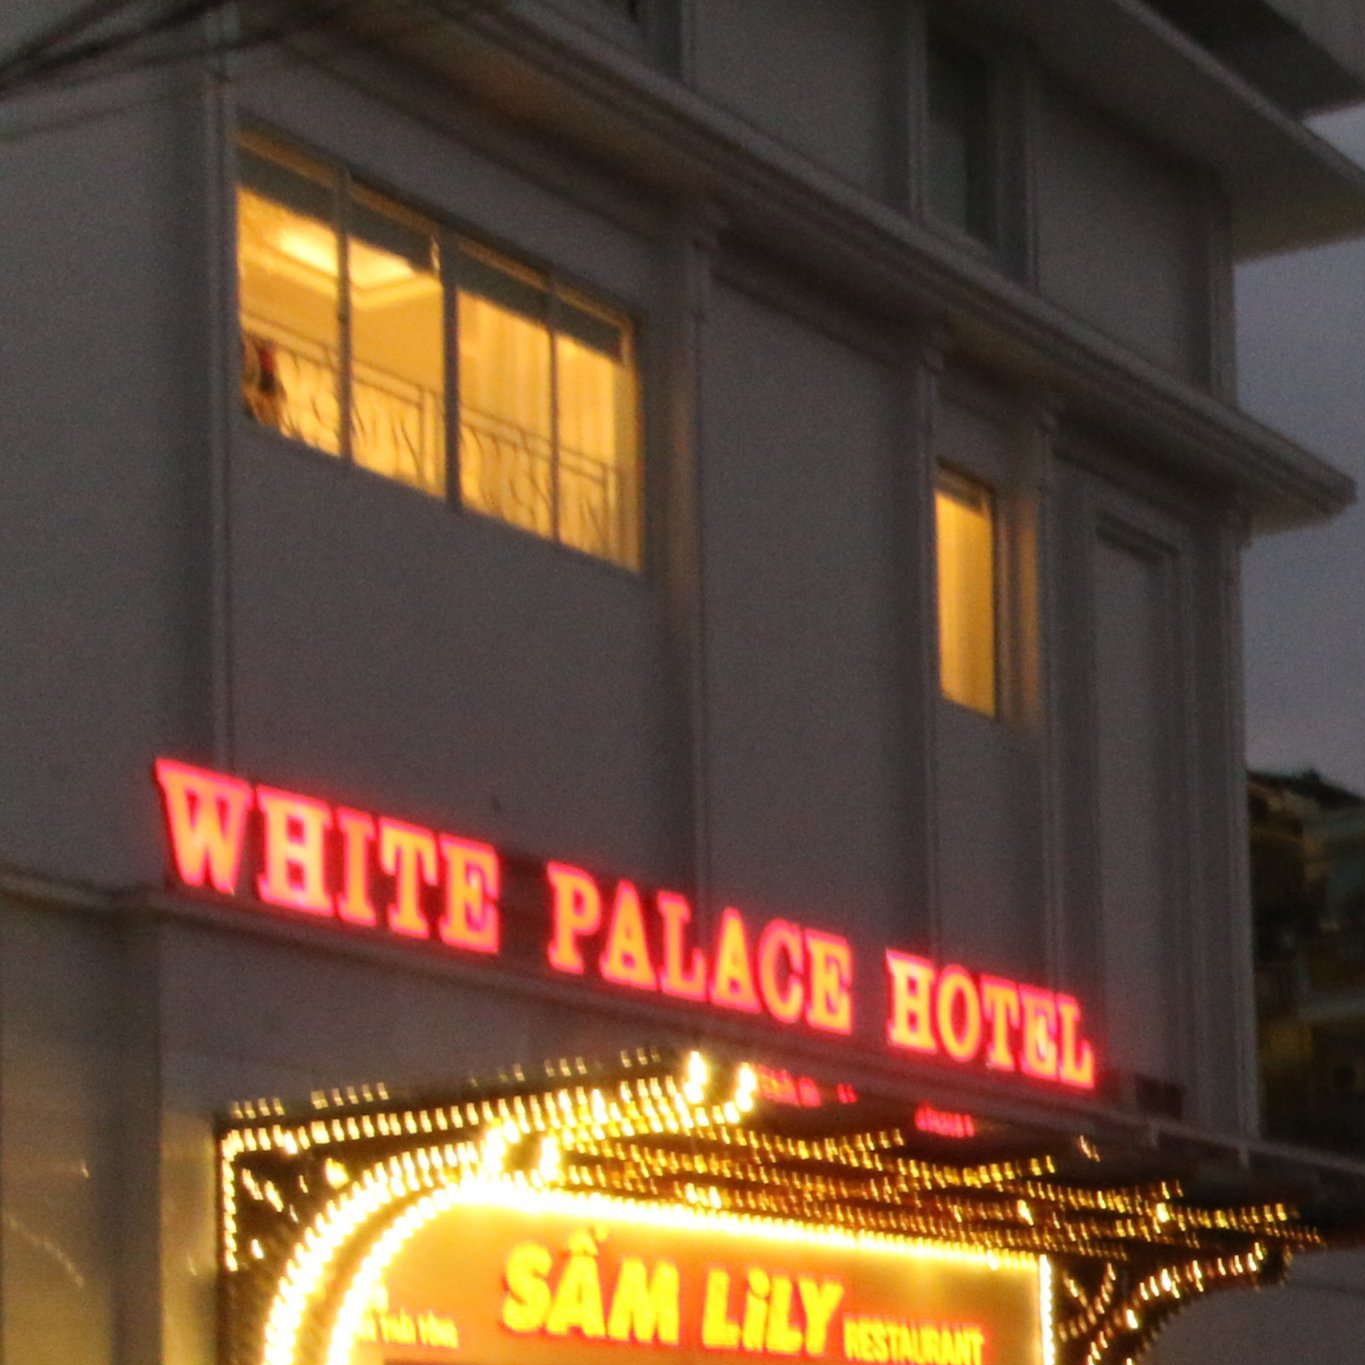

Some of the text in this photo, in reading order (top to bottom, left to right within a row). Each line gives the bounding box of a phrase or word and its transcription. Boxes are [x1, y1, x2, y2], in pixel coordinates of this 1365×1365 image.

[154, 756, 1098, 1091] WHITE PALACE HOTEL
